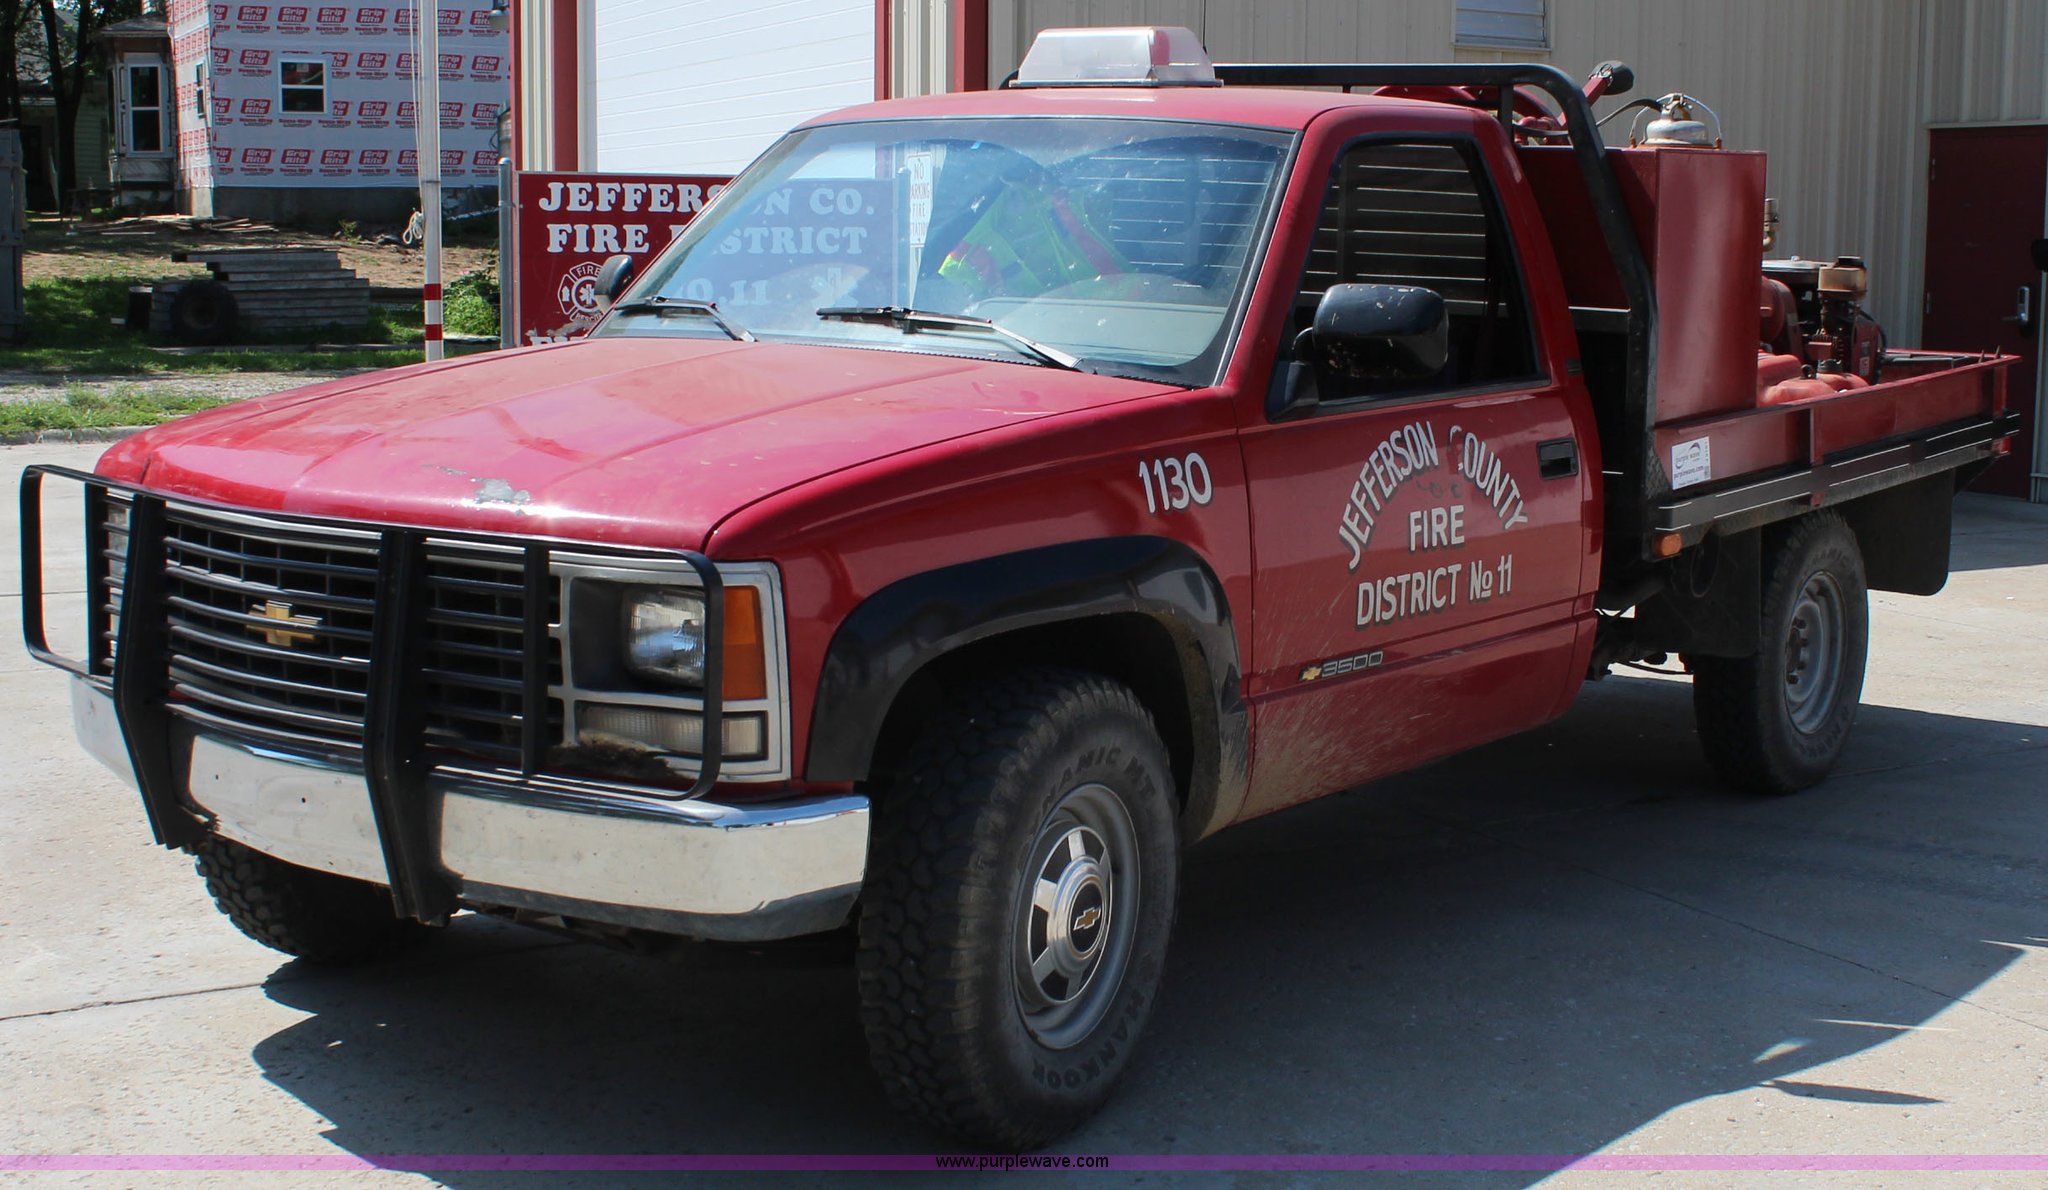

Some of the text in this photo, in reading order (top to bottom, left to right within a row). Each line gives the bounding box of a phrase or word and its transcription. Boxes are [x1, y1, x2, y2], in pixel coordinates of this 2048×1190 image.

[538, 182, 875, 215] JEFFERN CO.
[911, 183, 930, 199] ARKING
[546, 223, 868, 254] FIRE STRICT
[576, 265, 601, 277] FIRE
[1139, 452, 1212, 513] 1130
[1339, 421, 1439, 569] JEFFERSON
[1409, 505, 1465, 551] FIRE
[1357, 564, 1462, 625] DISTRICT
[1497, 554, 1512, 595] 11
[1321, 651, 1383, 677] 3500
